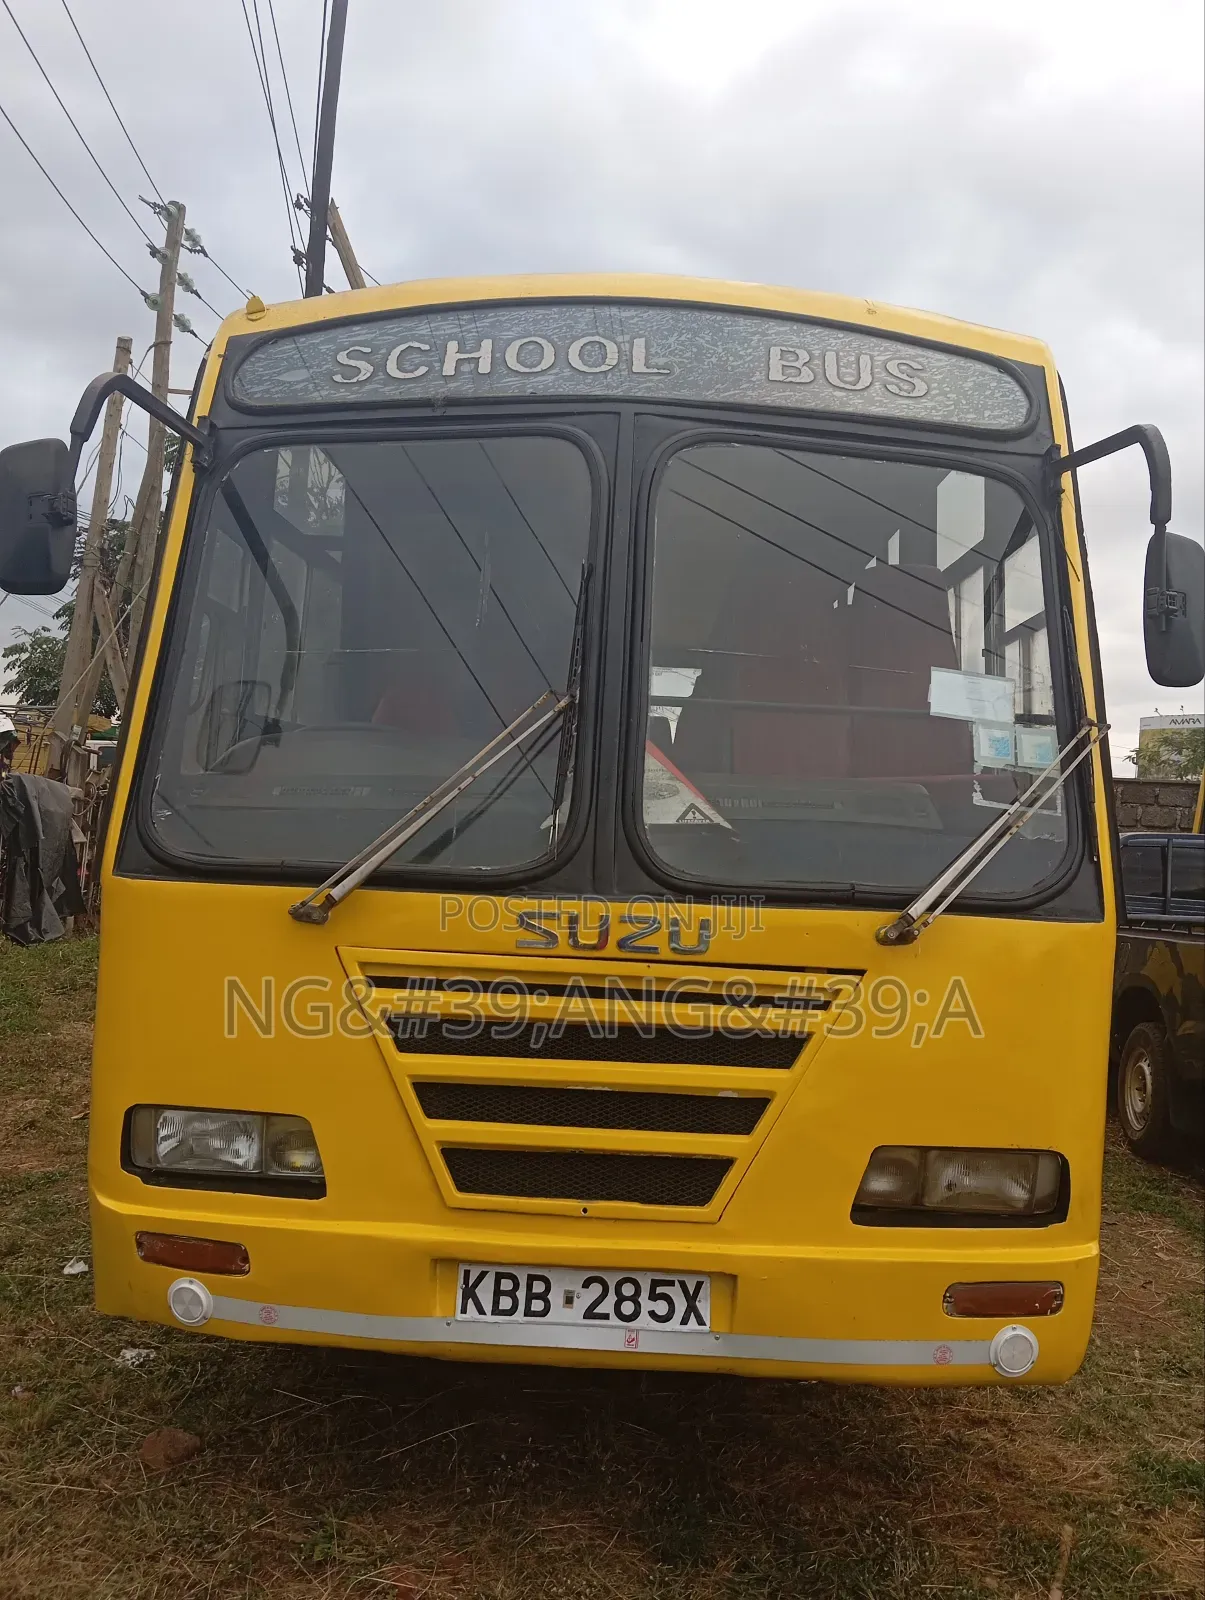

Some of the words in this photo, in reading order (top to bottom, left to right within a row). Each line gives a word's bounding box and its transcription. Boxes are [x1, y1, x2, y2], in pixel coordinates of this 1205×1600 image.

[332, 336, 671, 383] SCHOOL
[768, 346, 929, 398] BUS
[516, 911, 712, 955] SUZU
[460, 1269, 552, 1318] KBB
[581, 1275, 707, 1327] 285X
